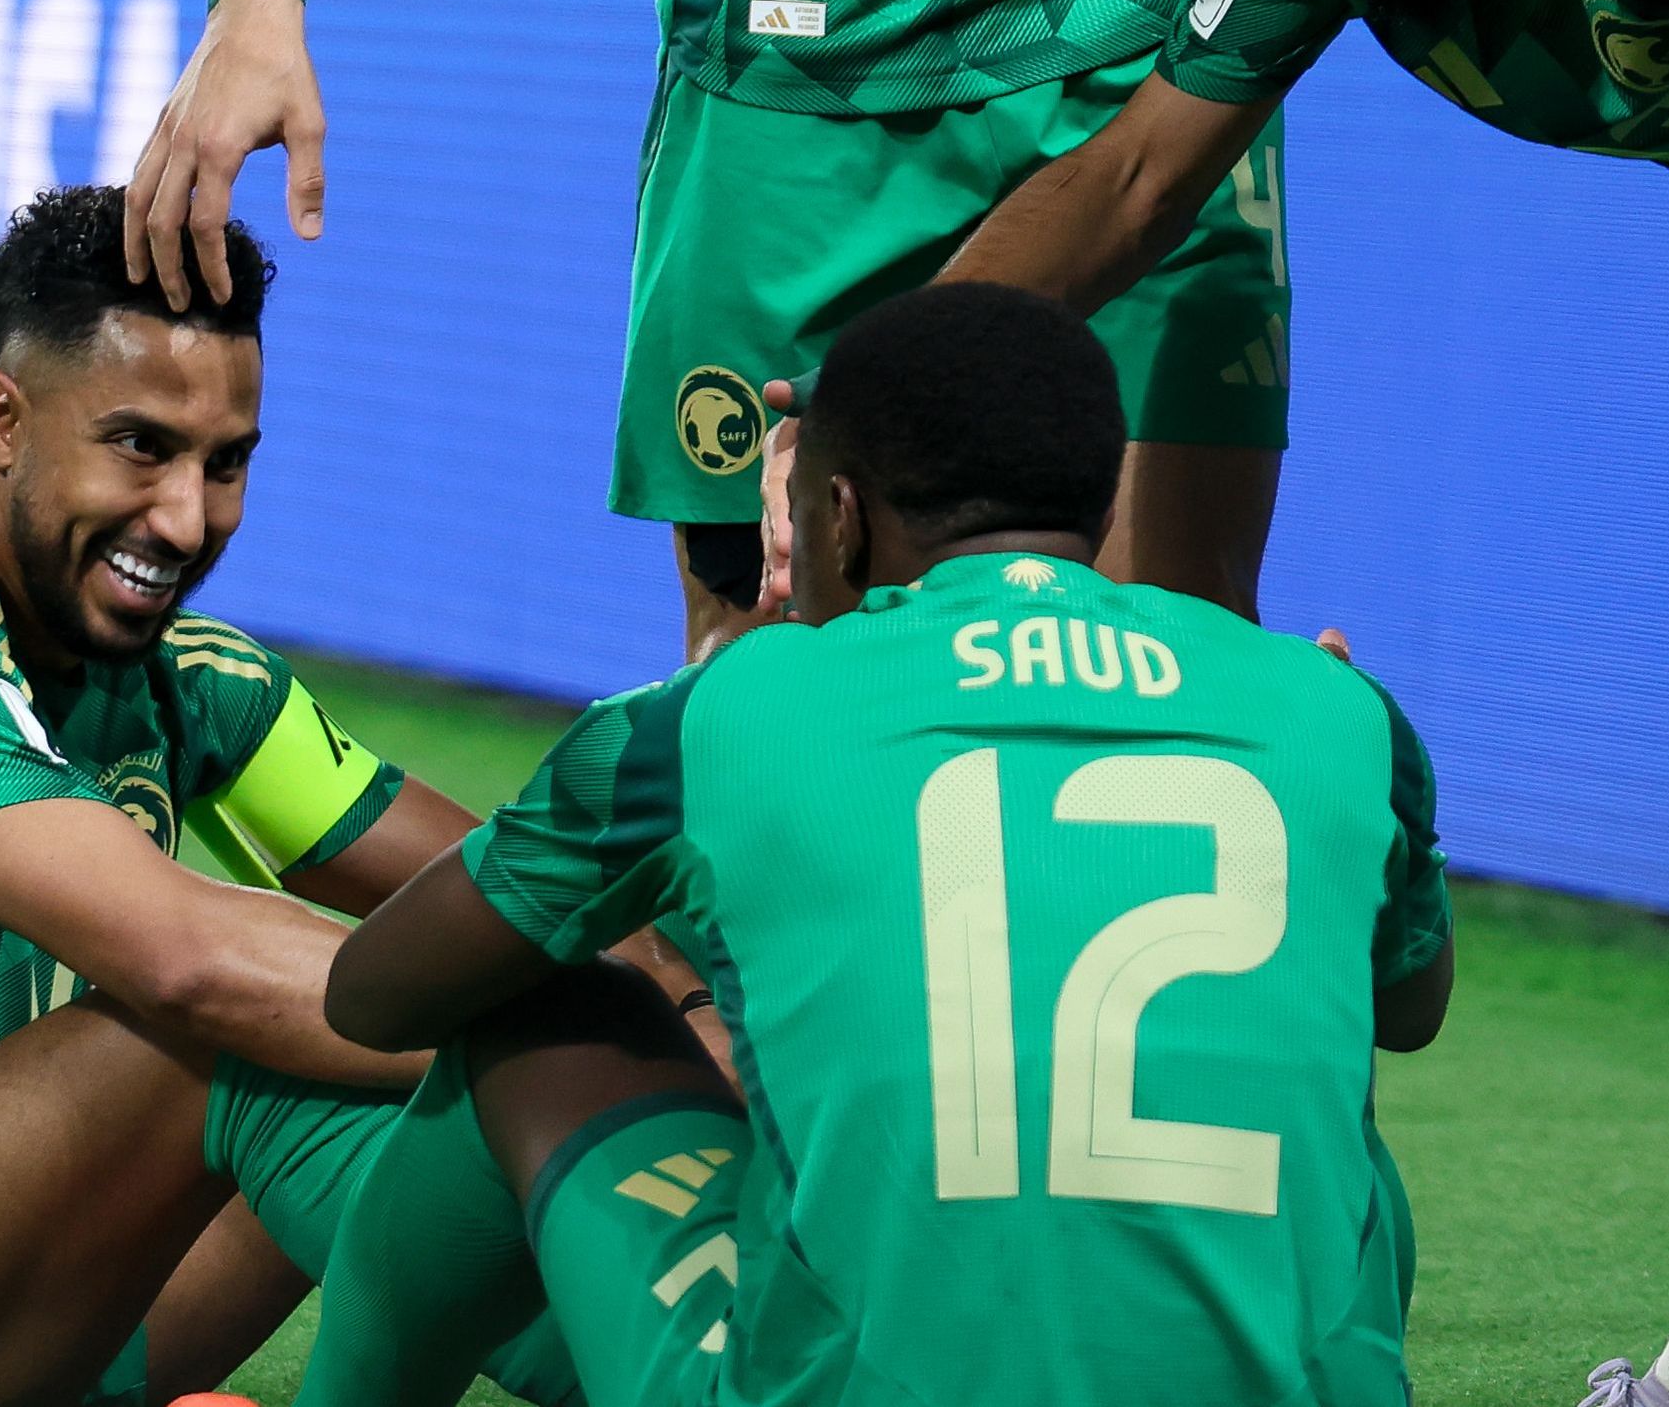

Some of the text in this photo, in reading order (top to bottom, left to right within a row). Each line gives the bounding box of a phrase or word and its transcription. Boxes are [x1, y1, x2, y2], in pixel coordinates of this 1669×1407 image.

[1231, 145, 1286, 287] 4
[719, 431, 748, 442] SAFF
[953, 617, 1181, 697] SAUD
[916, 747, 1288, 1217] 12
